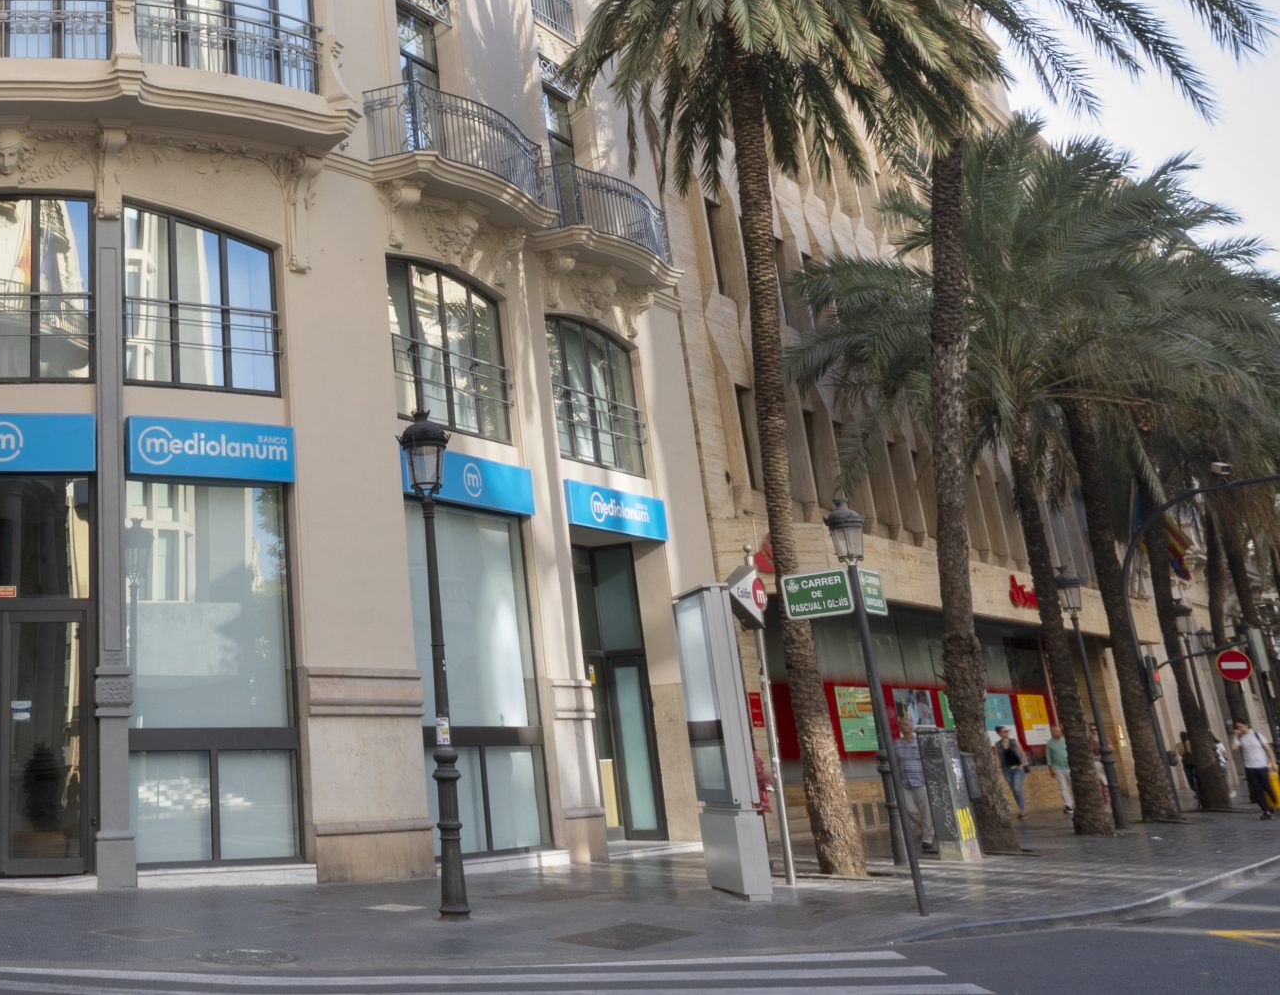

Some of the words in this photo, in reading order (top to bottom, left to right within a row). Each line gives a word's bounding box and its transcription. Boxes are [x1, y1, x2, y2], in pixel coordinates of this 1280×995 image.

[258, 435, 287, 445] BANCO
[146, 432, 288, 461] mediolanum
[593, 499, 650, 523] mediolanum
[801, 576, 841, 589] CARRER
[811, 590, 823, 598] DE
[791, 603, 822, 613] PASCUAL
